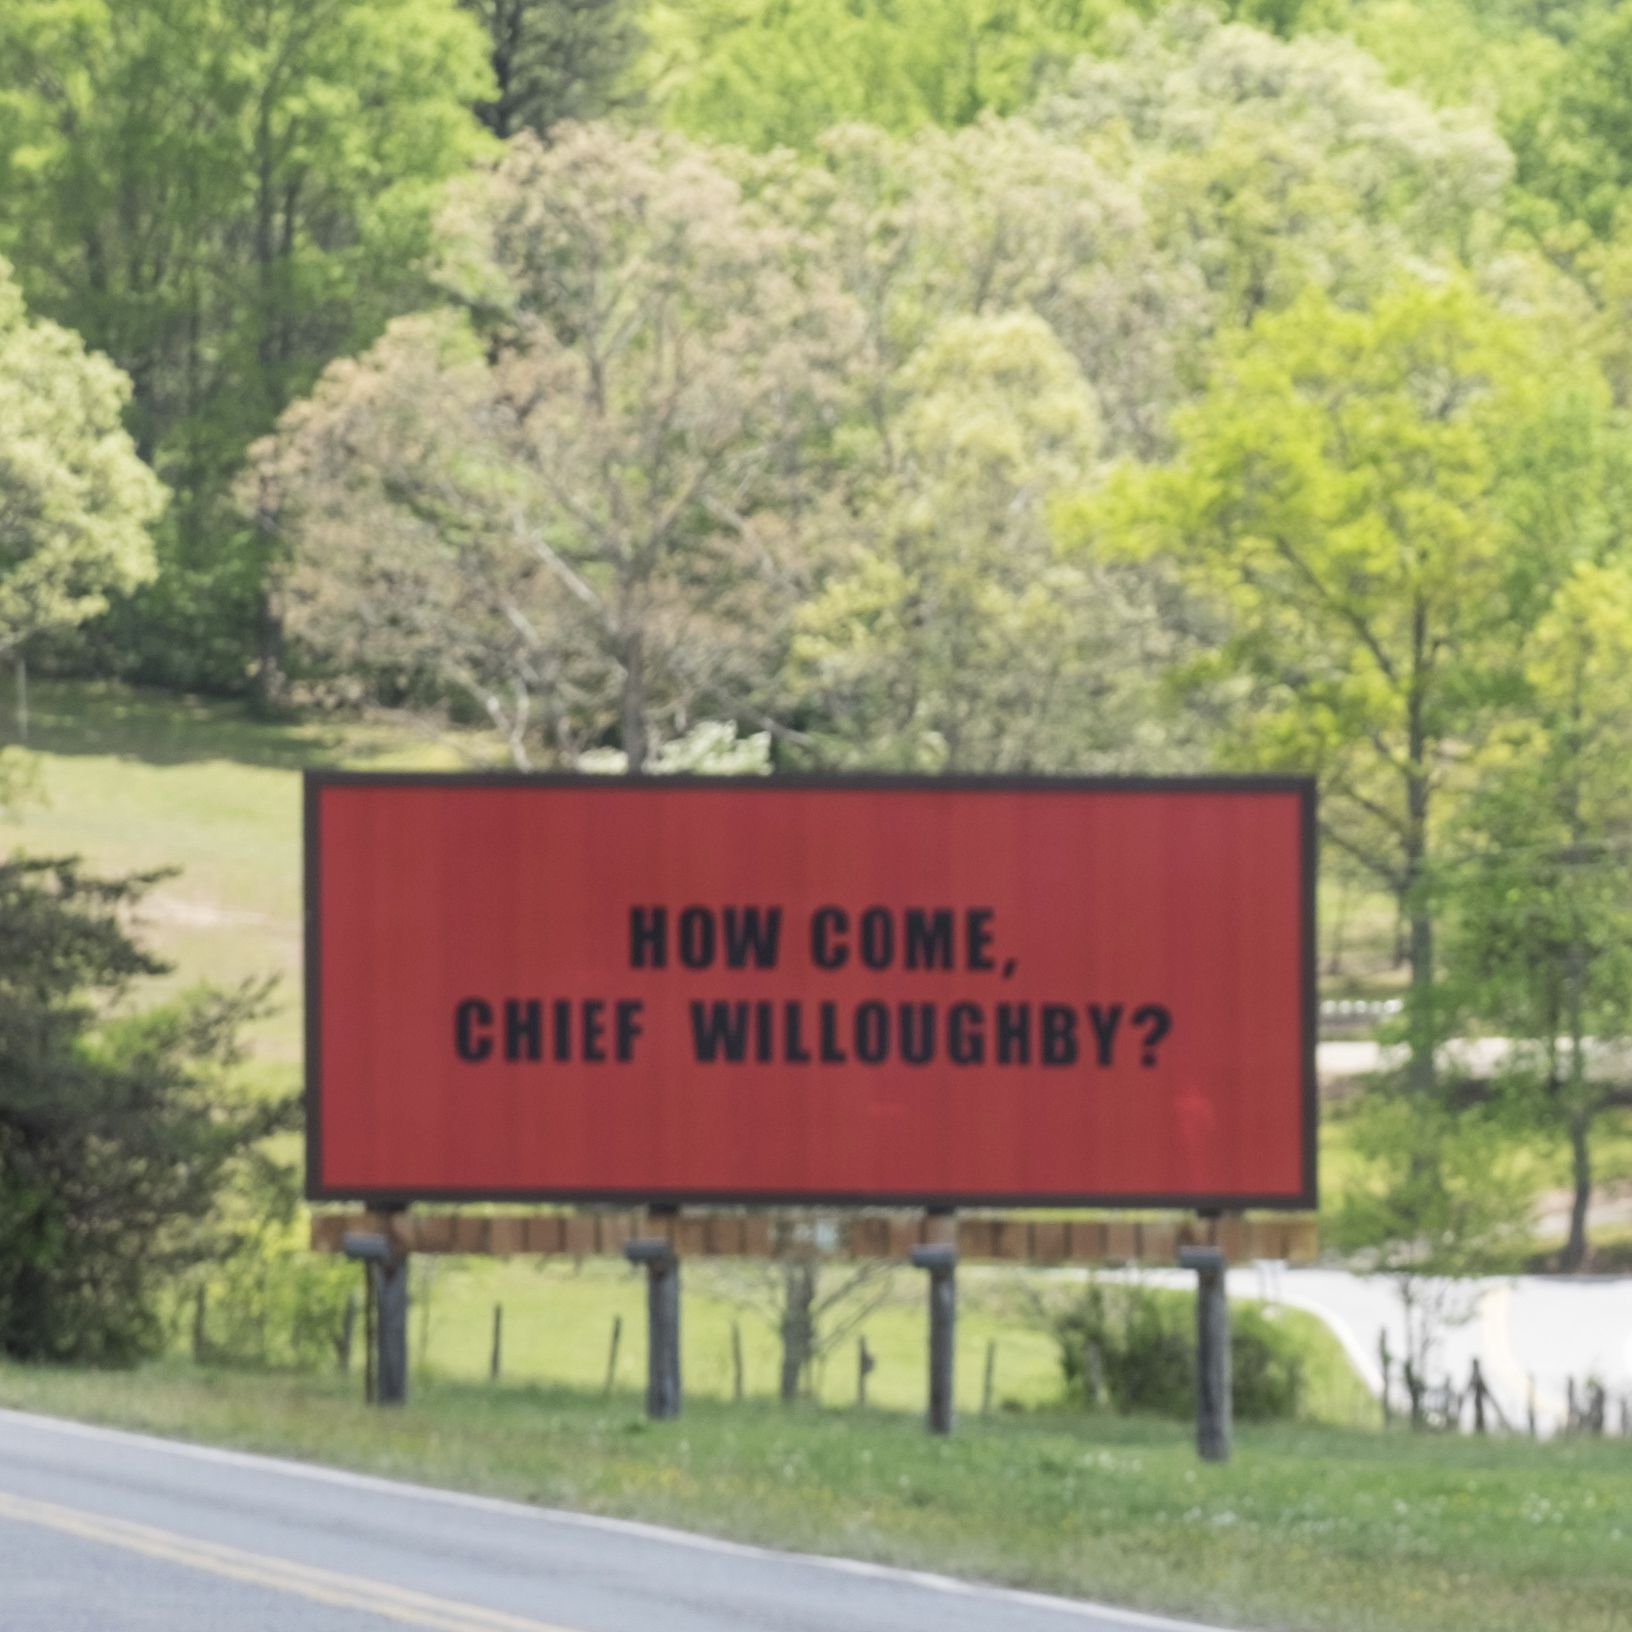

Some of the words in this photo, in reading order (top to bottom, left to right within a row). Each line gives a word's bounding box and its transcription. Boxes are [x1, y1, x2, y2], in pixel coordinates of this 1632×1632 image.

[627, 904, 784, 972] HOW
[809, 904, 1018, 980] COME,
[453, 996, 645, 1065] CHIEF
[688, 999, 1174, 1069] WILLOUGHBY?
